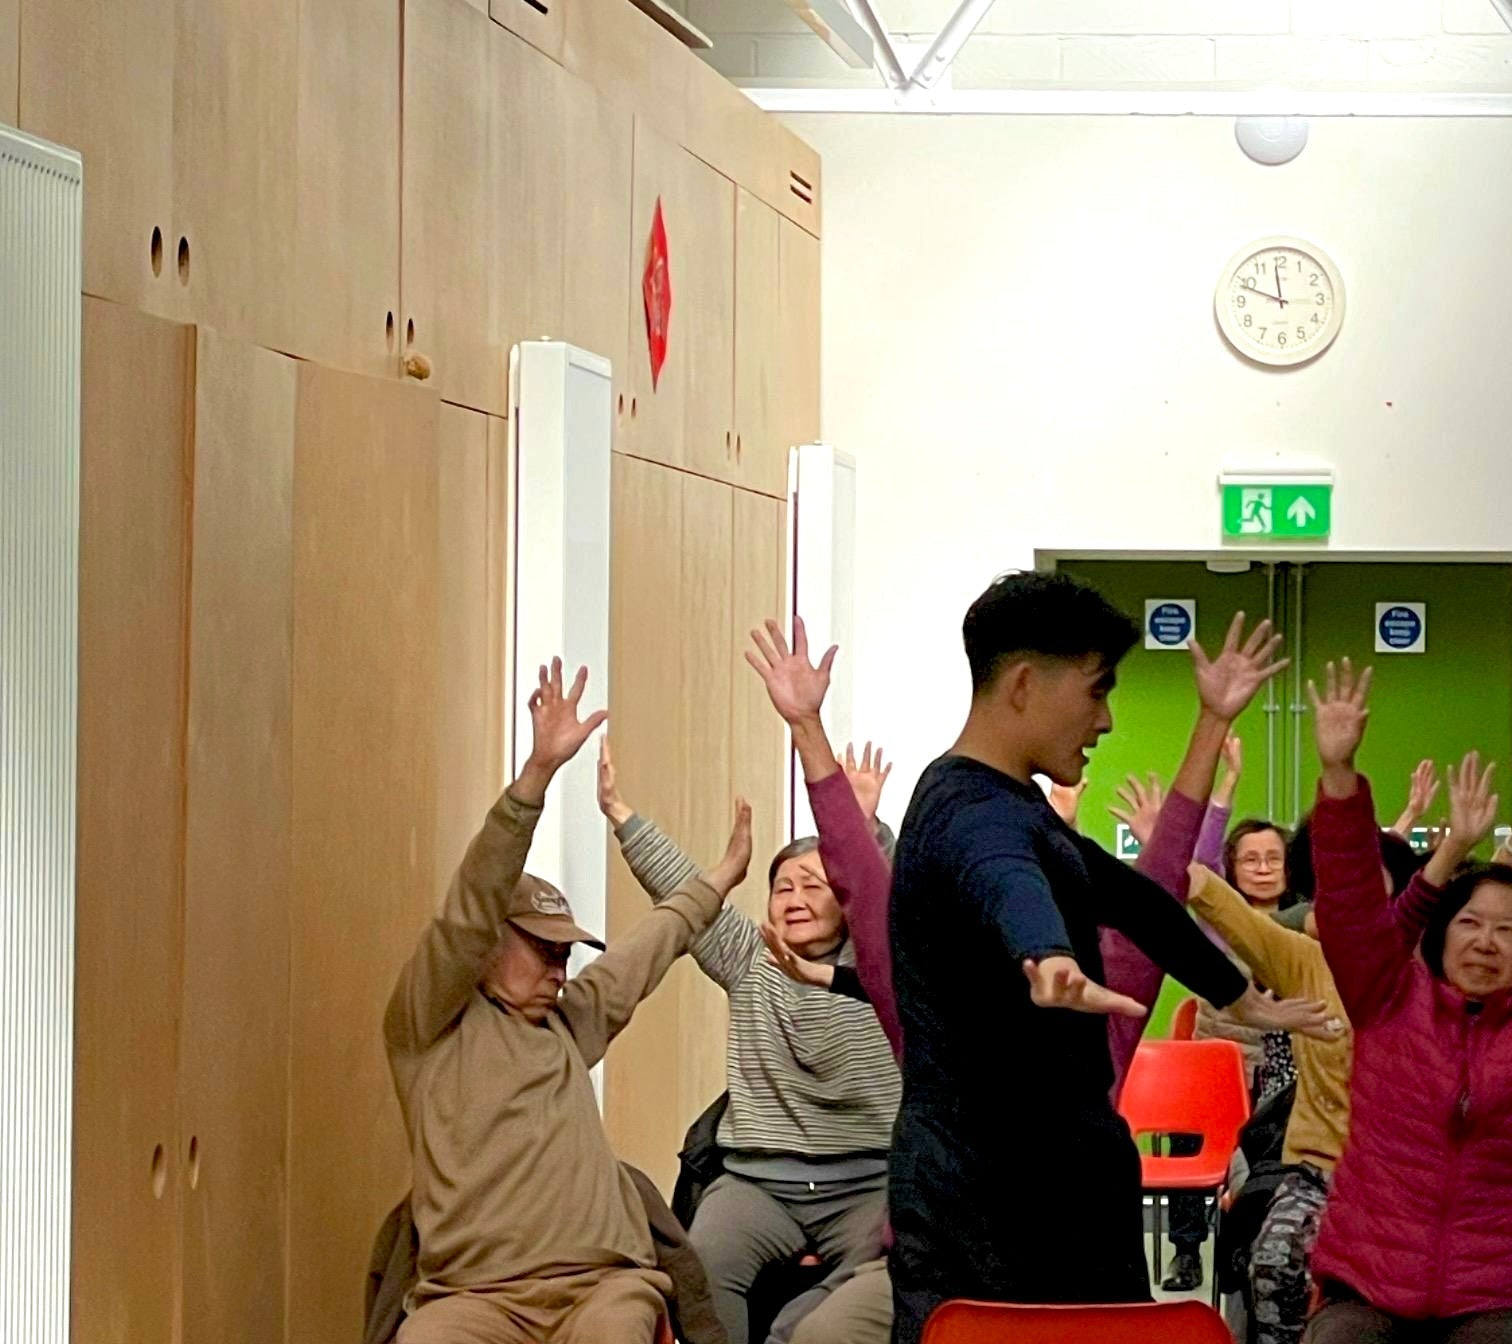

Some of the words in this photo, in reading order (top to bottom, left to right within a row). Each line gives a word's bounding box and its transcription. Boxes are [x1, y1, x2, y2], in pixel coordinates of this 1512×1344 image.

[1254, 261, 1266, 275] 11
[1296, 260, 1302, 273] 1
[1309, 273, 1319, 286] 2
[1236, 295, 1246, 308] 9
[1315, 293, 1325, 306] 3
[1243, 314, 1252, 328] 8
[1310, 312, 1319, 324] 4
[1258, 327, 1267, 340] 7
[1277, 331, 1287, 345] 6
[1296, 326, 1305, 340] 5
